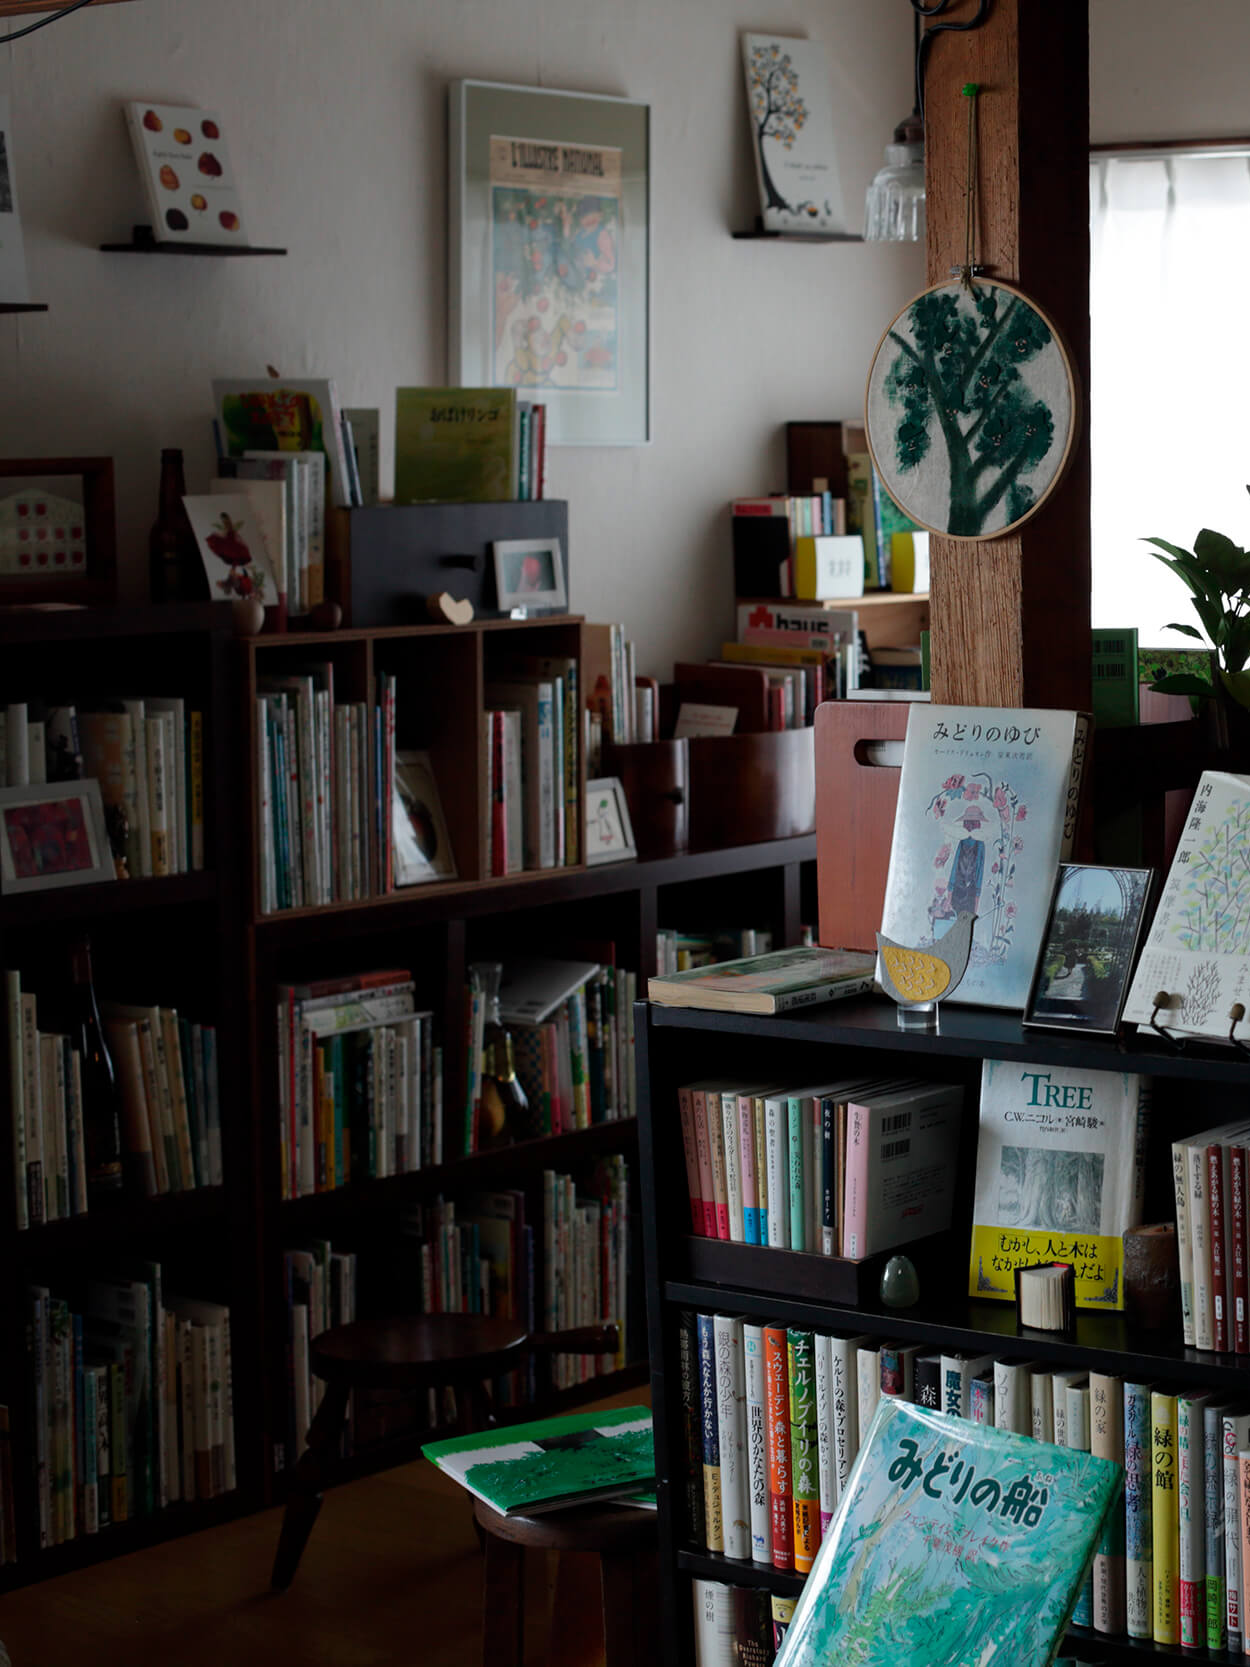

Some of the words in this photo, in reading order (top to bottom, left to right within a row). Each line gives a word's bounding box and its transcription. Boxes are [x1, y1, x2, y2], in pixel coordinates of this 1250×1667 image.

[932, 722, 1042, 745] みどりのゆび
[1063, 729, 1088, 839] みどりのゆび
[1177, 783, 1214, 865] 内海隆一郎
[1021, 1072, 1094, 1110] TREE
[999, 1234, 1098, 1259] むかし、人と木は
[701, 1326, 714, 1439] もう森へなんか行かない
[772, 1352, 785, 1417] スウェーデン
[919, 1384, 938, 1407] 森
[945, 1369, 963, 1418] 魔女の
[1094, 1387, 1107, 1435] 緑の家
[795, 1340, 816, 1494] チェルノブイリの森
[751, 1405, 766, 1507] 世界のかなたの森
[774, 1421, 789, 1495] 森と暮らす
[889, 1437, 1049, 1529] みどりの船
[1125, 1440, 1142, 1512] 緑の思考
[1154, 1426, 1174, 1490] 緑の館
[1204, 1432, 1220, 1530] 緑の黙示録
[1206, 1578, 1219, 1630] 岡崎二郎
